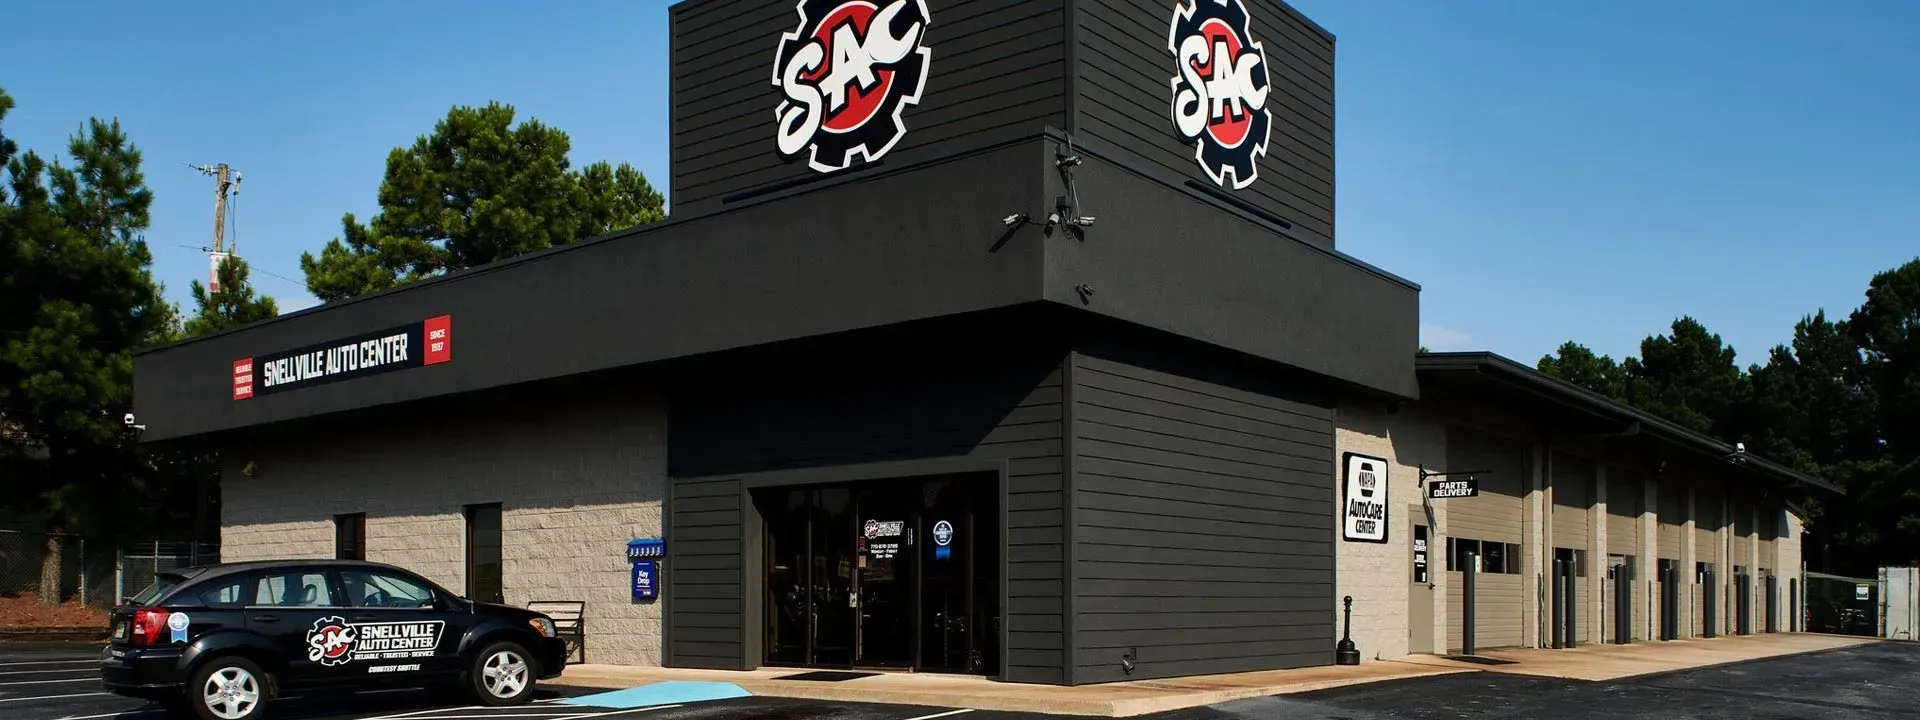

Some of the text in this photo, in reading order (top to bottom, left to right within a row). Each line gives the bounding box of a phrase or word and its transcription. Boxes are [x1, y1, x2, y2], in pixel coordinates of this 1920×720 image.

[777, 0, 921, 155] SAC
[1175, 35, 1269, 137] SAC
[430, 328, 446, 340] SINCE
[264, 333, 408, 387] SNELLVILLE AUTO CENTER
[1433, 487, 1473, 497] DELIVERY
[1439, 481, 1468, 490] PARTS
[1355, 519, 1376, 535] CENTER
[637, 577, 650, 585] Drop
[638, 570, 648, 578] Key
[361, 624, 435, 640] SNELLVILLE
[309, 627, 356, 661] SAC
[358, 637, 434, 651] AUTO CENTER
